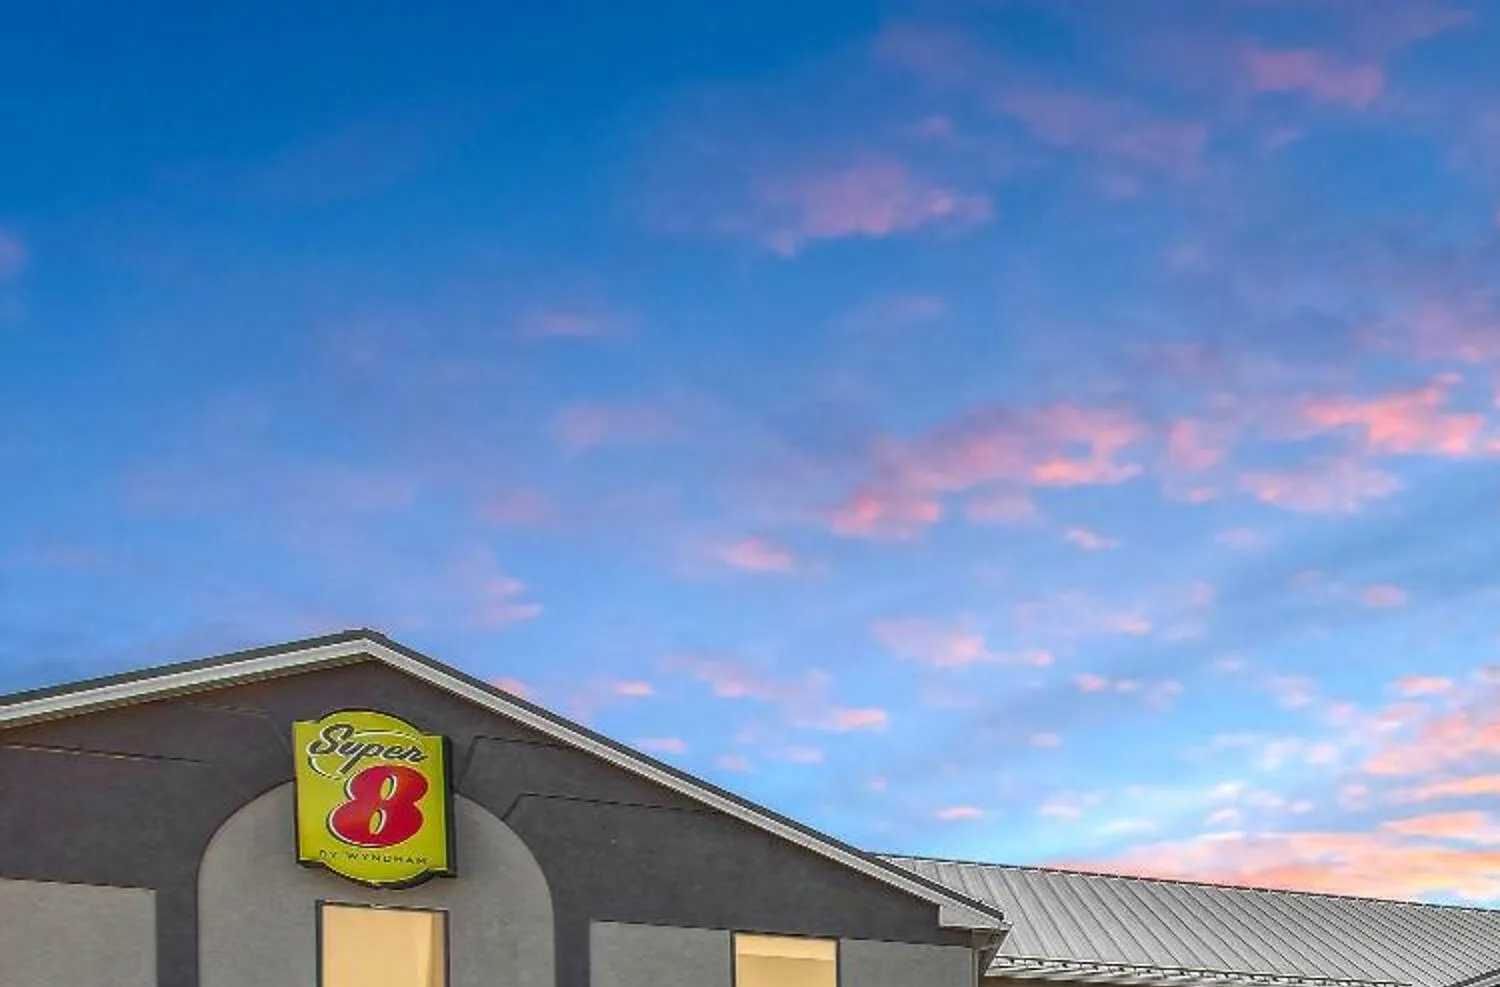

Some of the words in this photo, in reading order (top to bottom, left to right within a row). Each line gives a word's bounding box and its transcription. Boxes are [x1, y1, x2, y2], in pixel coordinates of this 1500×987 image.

[307, 723, 428, 779] Super
[326, 764, 428, 848] 8
[346, 851, 428, 865] WYNDHAM
